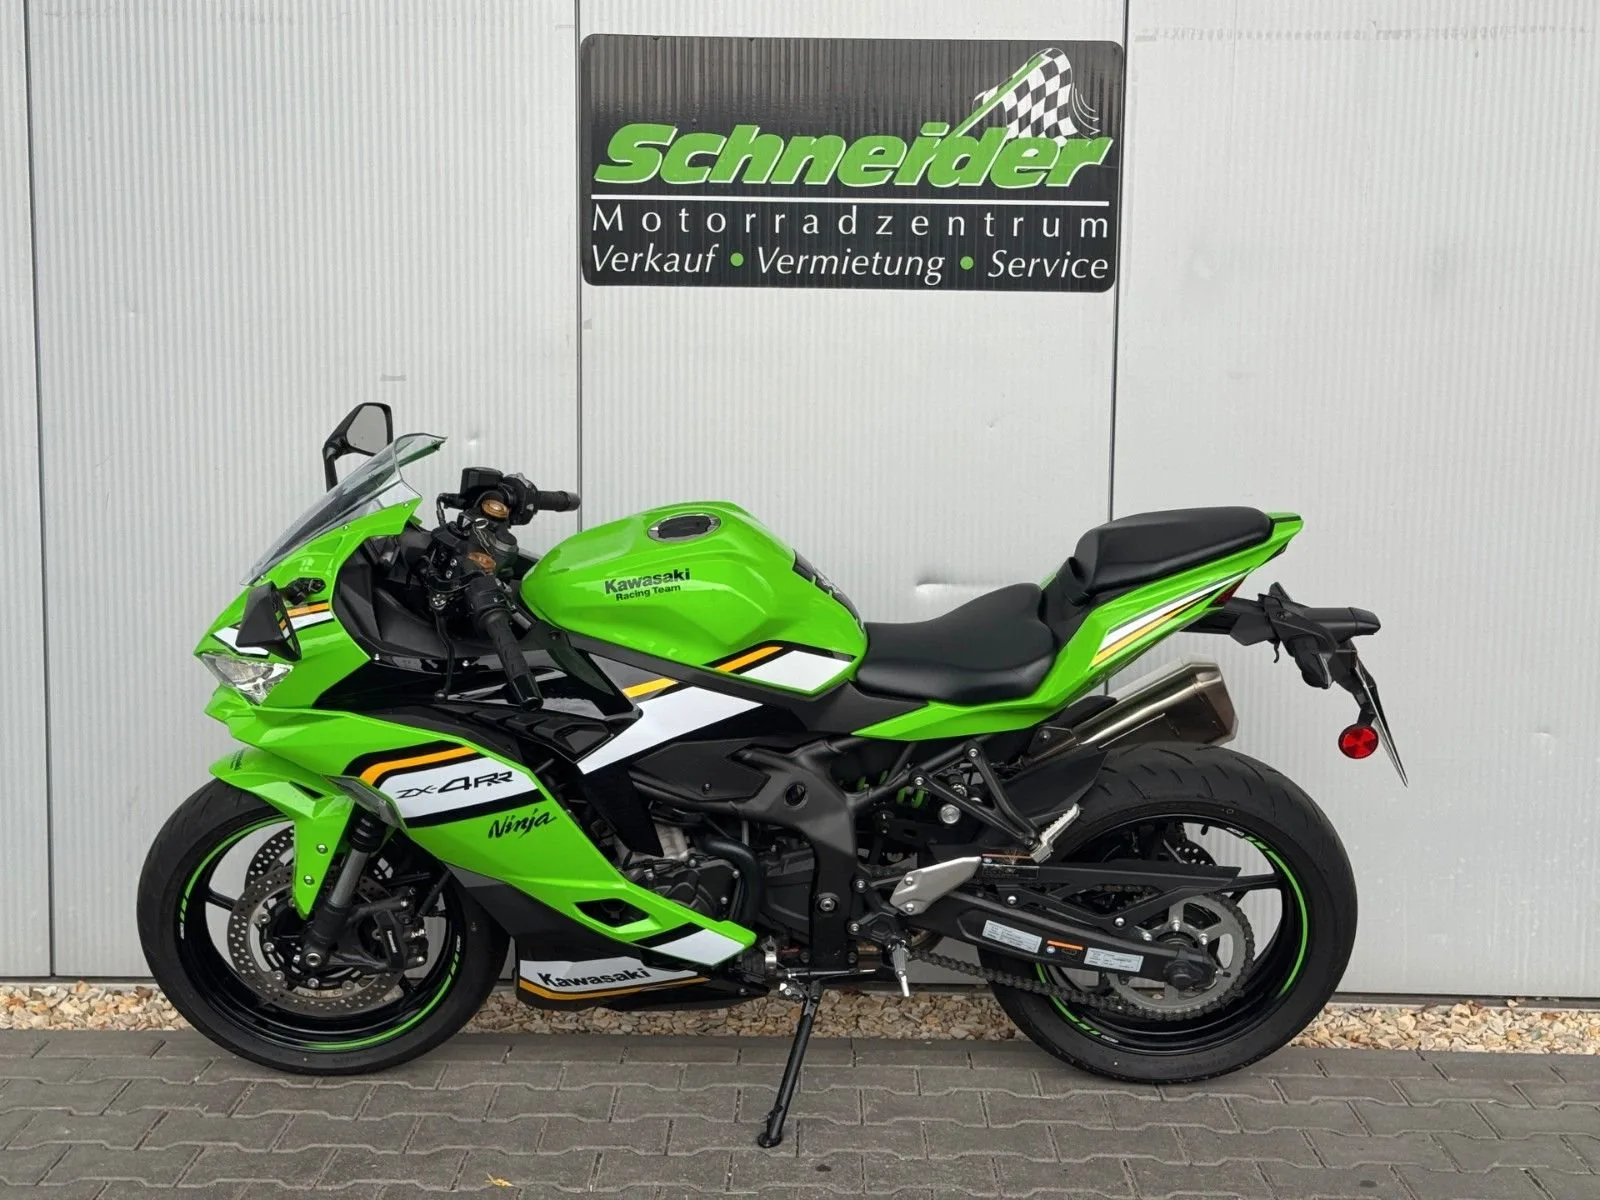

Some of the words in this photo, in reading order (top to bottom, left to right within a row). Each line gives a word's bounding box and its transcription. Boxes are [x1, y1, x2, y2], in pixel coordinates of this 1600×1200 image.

[593, 123, 1114, 189] Schneider
[592, 244, 719, 275] Verkauf
[757, 246, 945, 286] Vermietung
[987, 250, 1109, 280] Service
[604, 567, 691, 594] Kawasaki
[615, 589, 651, 601] Racing
[652, 584, 681, 594] Team
[488, 808, 557, 839] Ninja
[537, 967, 652, 987] Kawasaki
